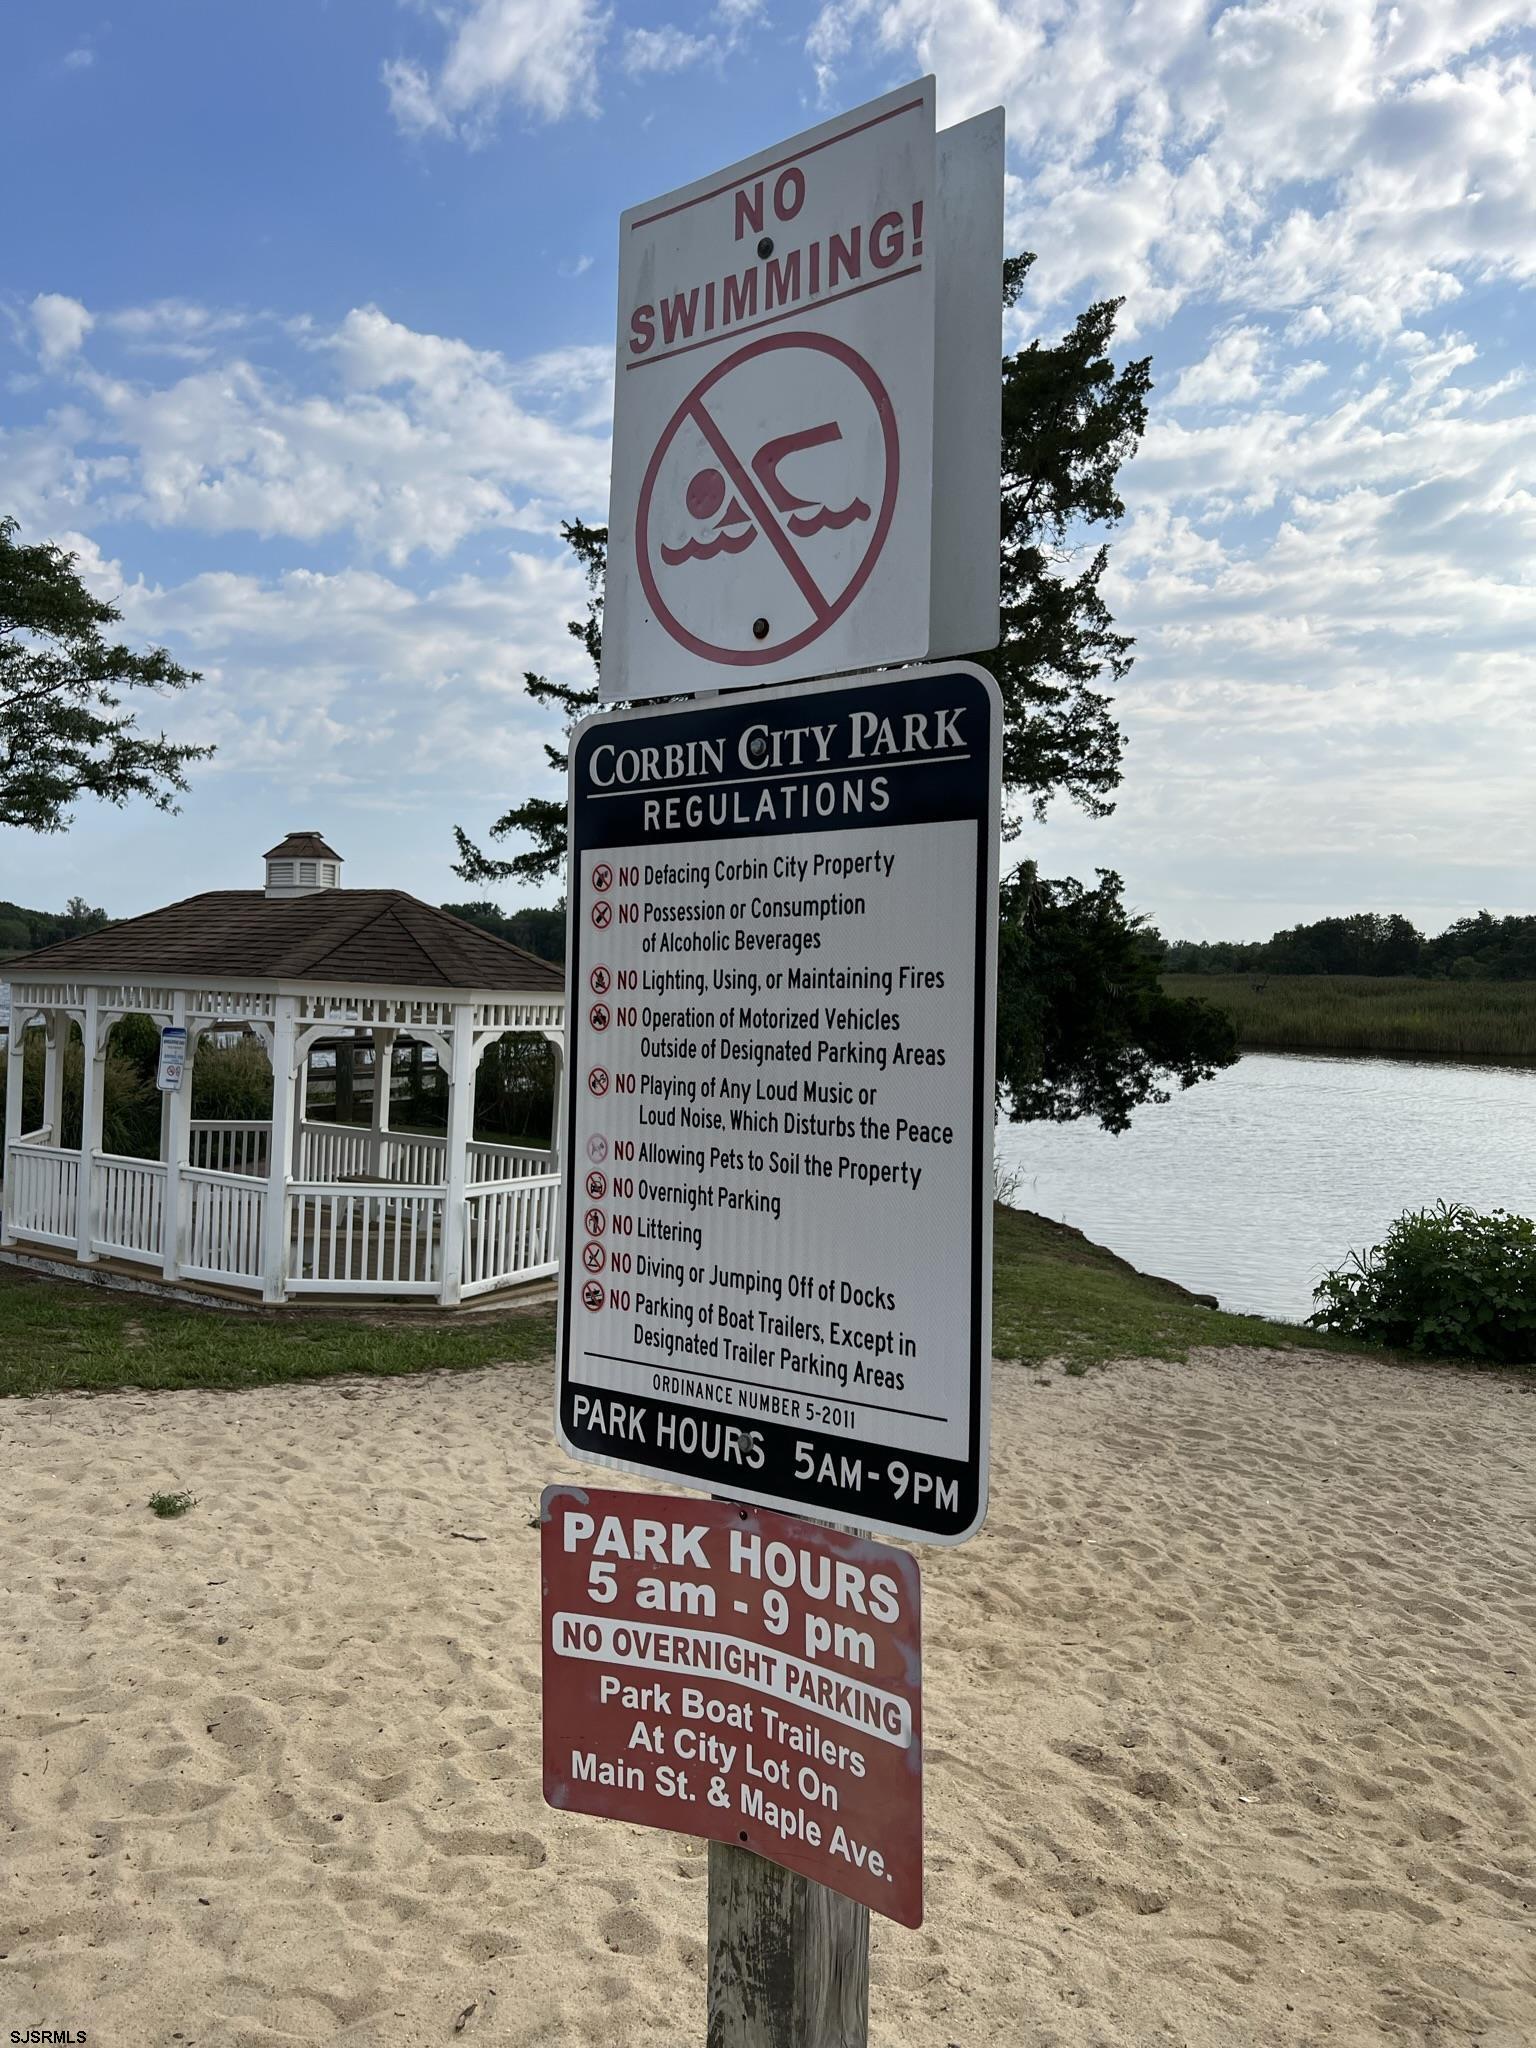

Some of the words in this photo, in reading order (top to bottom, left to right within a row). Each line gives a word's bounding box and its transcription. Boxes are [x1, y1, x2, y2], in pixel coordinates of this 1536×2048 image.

[734, 167, 806, 241] NO
[629, 200, 923, 354] SWIMMING!
[589, 738, 726, 787] CORBIN
[738, 723, 838, 770] CITY
[848, 707, 967, 759] PARK
[644, 776, 890, 831] REGULATIONS
[619, 866, 639, 887] NO
[644, 864, 710, 889] Defacing
[715, 855, 767, 882] Corbin
[773, 855, 808, 882] City
[813, 850, 895, 877] Property
[618, 903, 639, 923] NO
[643, 901, 725, 923] Possession
[730, 899, 746, 919] or
[751, 893, 865, 921] Consumption
[642, 933, 656, 953] of
[660, 931, 729, 953] Alcoholic
[735, 929, 821, 955] Beverages
[617, 970, 637, 990] NO
[642, 970, 708, 996] Lighting,
[713, 968, 761, 992] Using,
[766, 971, 783, 989] or
[788, 968, 892, 996] Maintaining
[899, 965, 945, 989] Fires
[617, 1007, 637, 1027] NO
[642, 1007, 715, 1030] Operation
[719, 1007, 734, 1029] of
[739, 1007, 819, 1030] Motorized
[825, 1008, 900, 1031] Vehicles
[640, 1037, 696, 1059] Outside
[701, 1038, 716, 1060] of
[721, 1039, 812, 1067] Designated
[817, 1041, 886, 1070] Parking
[892, 1043, 946, 1066] Areas
[616, 1074, 635, 1094] NO
[641, 1074, 696, 1102] Playing
[700, 1076, 716, 1097] of
[719, 1077, 751, 1102] Any
[756, 1077, 798, 1100] Loud
[803, 1080, 853, 1104] Music
[858, 1084, 877, 1105] or
[639, 1105, 675, 1127] Loud
[680, 1108, 725, 1131] Noise,
[730, 1110, 778, 1133] Which
[784, 1112, 855, 1138] Disturbs
[860, 1116, 890, 1140] the
[896, 1119, 953, 1144] Peace
[614, 1141, 634, 1161] NO
[639, 1143, 705, 1172] Allowing
[710, 1148, 744, 1170] Pets
[748, 1150, 764, 1171] to
[769, 1151, 800, 1174] Soil
[804, 1154, 833, 1177] the
[838, 1157, 922, 1190] Property
[613, 1178, 633, 1198] NO
[638, 1179, 714, 1211] Overnight
[718, 1187, 781, 1219] Parking
[612, 1215, 633, 1235] NO
[637, 1217, 702, 1250] Littering
[611, 1253, 632, 1273] NO
[636, 1255, 684, 1286] Diving
[689, 1263, 704, 1283] or
[709, 1266, 782, 1301] Jumping
[788, 1275, 813, 1299] Off
[818, 1279, 835, 1302] of
[840, 1282, 895, 1311] Docks
[610, 1290, 631, 1311] NO
[635, 1293, 693, 1328] Parking
[698, 1302, 714, 1324] of
[718, 1305, 754, 1331] Boat
[759, 1311, 825, 1344] Trailers,
[830, 1323, 894, 1357] Except
[898, 1333, 916, 1357] in
[634, 1324, 718, 1358] Designated
[723, 1339, 775, 1368] Trailer
[780, 1348, 848, 1387] Parking
[853, 1361, 904, 1391] Areas
[653, 1374, 732, 1405] ORDINANCE
[738, 1390, 800, 1418] NUMBER
[806, 1404, 855, 1429] 5-2011
[573, 1394, 646, 1444] PARK
[657, 1412, 765, 1469] HOURS
[563, 1512, 711, 1569] PARK
[730, 1530, 900, 1624] HOURS
[587, 1562, 618, 1603] 5
[636, 1578, 716, 1617] am
[763, 1589, 789, 1635] 9
[806, 1613, 876, 1669] pm
[562, 1621, 602, 1652] NO
[612, 1629, 776, 1686] OVERNIGHT
[786, 1665, 901, 1736] PARKING
[600, 1675, 672, 1715] Park
[682, 1688, 753, 1732] Boat
[761, 1707, 866, 1778] Trailers
[628, 1721, 665, 1755] At
[674, 1728, 736, 1774] City
[746, 1744, 790, 1789] Lot
[799, 1768, 838, 1811] On
[571, 1750, 645, 1791] Main
[656, 1765, 696, 1801] St.
[707, 1776, 731, 1809] &
[740, 1784, 822, 1846] Maple
[829, 1825, 893, 1882] Ave.
